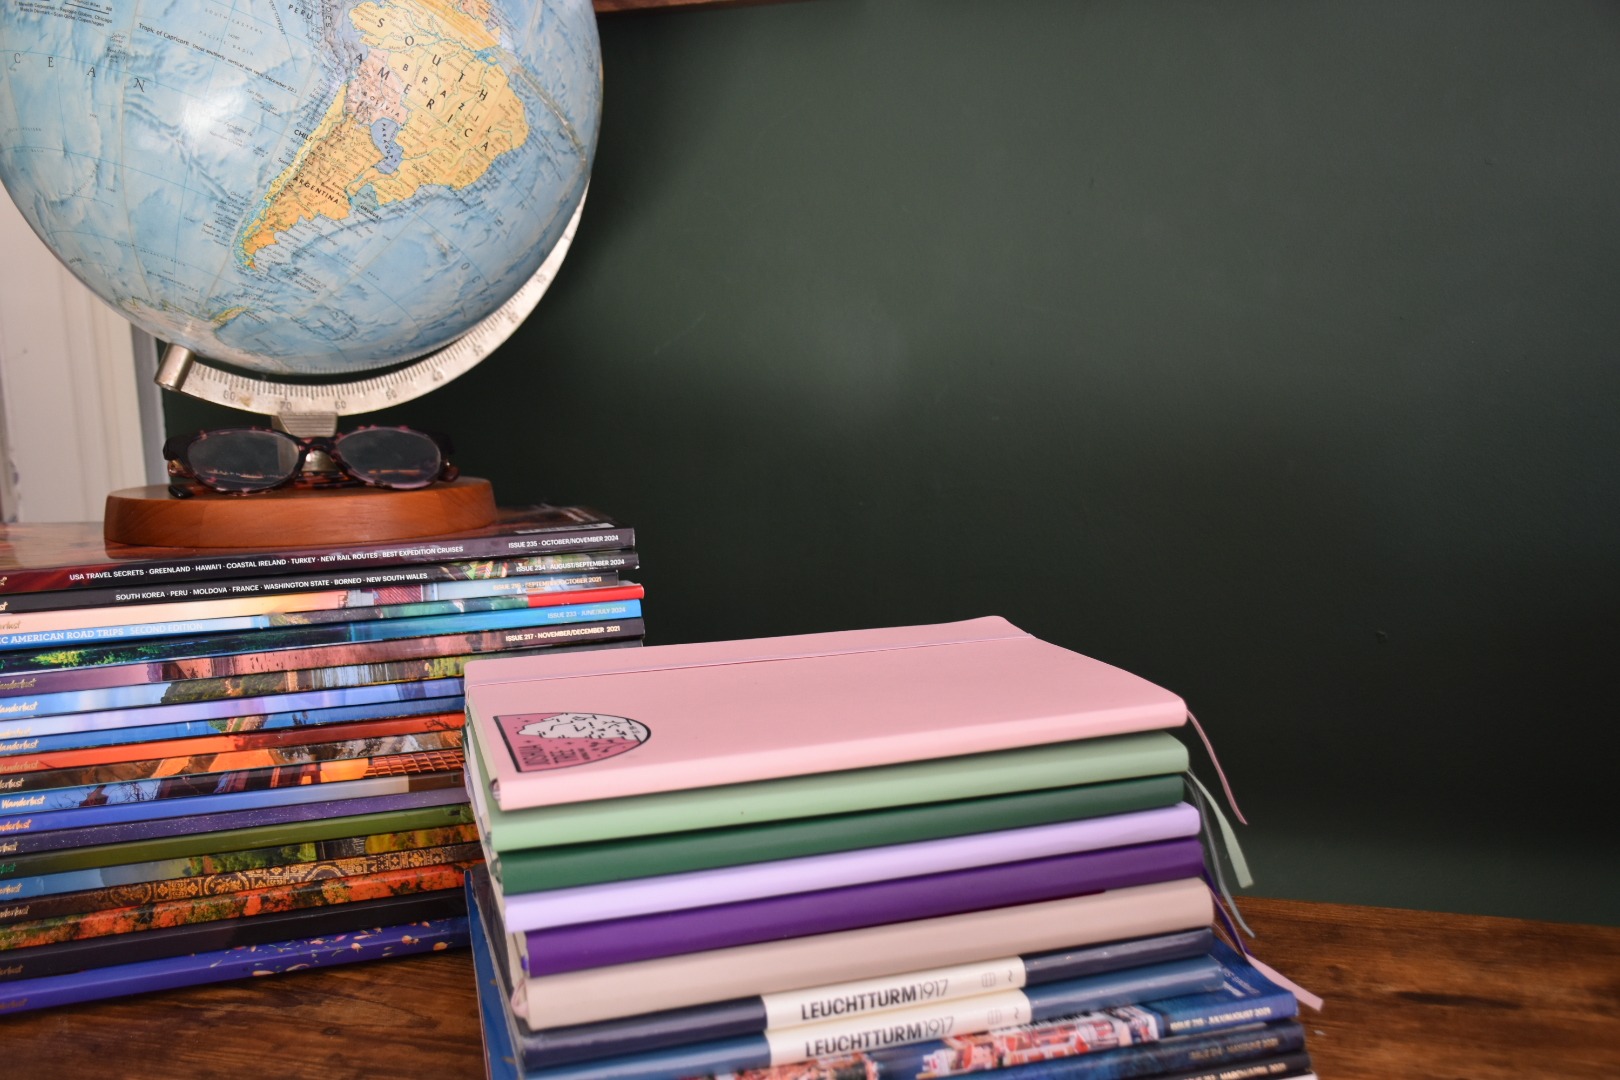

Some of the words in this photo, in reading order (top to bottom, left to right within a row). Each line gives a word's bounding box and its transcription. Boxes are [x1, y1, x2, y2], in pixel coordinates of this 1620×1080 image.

[288, 4, 312, 19] PERU
[138, 23, 153, 34] Tropic
[294, 129, 313, 142] CHILE
[293, 176, 339, 204] ARGENTINA
[360, 205, 382, 220] URUGUAY
[280, 401, 292, 410] 70
[335, 402, 346, 410] 60
[508, 541, 525, 549] ISSUE
[541, 537, 604, 546] OCTOBER/NOVEMBER
[69, 573, 84, 581] USA
[86, 571, 112, 580] TRAVEL
[114, 568, 144, 578] SECRETS
[149, 565, 191, 575] GREENLAND
[226, 561, 257, 569] COASTAL
[258, 559, 286, 567] IRELAND
[291, 556, 316, 565] TURKEY
[352, 551, 378, 560] ROUTES
[382, 549, 398, 558] BEST
[399, 547, 436, 557] EXPEDITION
[437, 546, 463, 555] CRUISES
[550, 561, 609, 570] AUGUST/SEPTEMBER
[116, 592, 141, 601] SOUTH
[142, 590, 165, 599] KOREA
[170, 589, 188, 597] PERU
[193, 587, 228, 596] MOLDOVA
[232, 584, 259, 593] FRANCE
[264, 580, 308, 590] WASHINGTON
[309, 579, 332, 587] STATE
[334, 577, 362, 585] BORNEO
[382, 574, 403, 582] SOUTH
[525, 578, 588, 588] SEPTEMBER/OCTOBER
[581, 608, 611, 616] JUNE/JULY
[10, 631, 64, 644] AMERICAN
[66, 629, 95, 640] ROAD
[96, 628, 124, 638] TRIPS
[130, 625, 166, 635] SECOND
[168, 622, 203, 633] EDITION
[538, 628, 604, 639] NOVEMBER/DECEMBER
[2, 796, 46, 809] Wanderlust
[801, 979, 949, 1020] LEUCHTTURM1917
[806, 1016, 954, 1057] LEUCHTTURM1917
